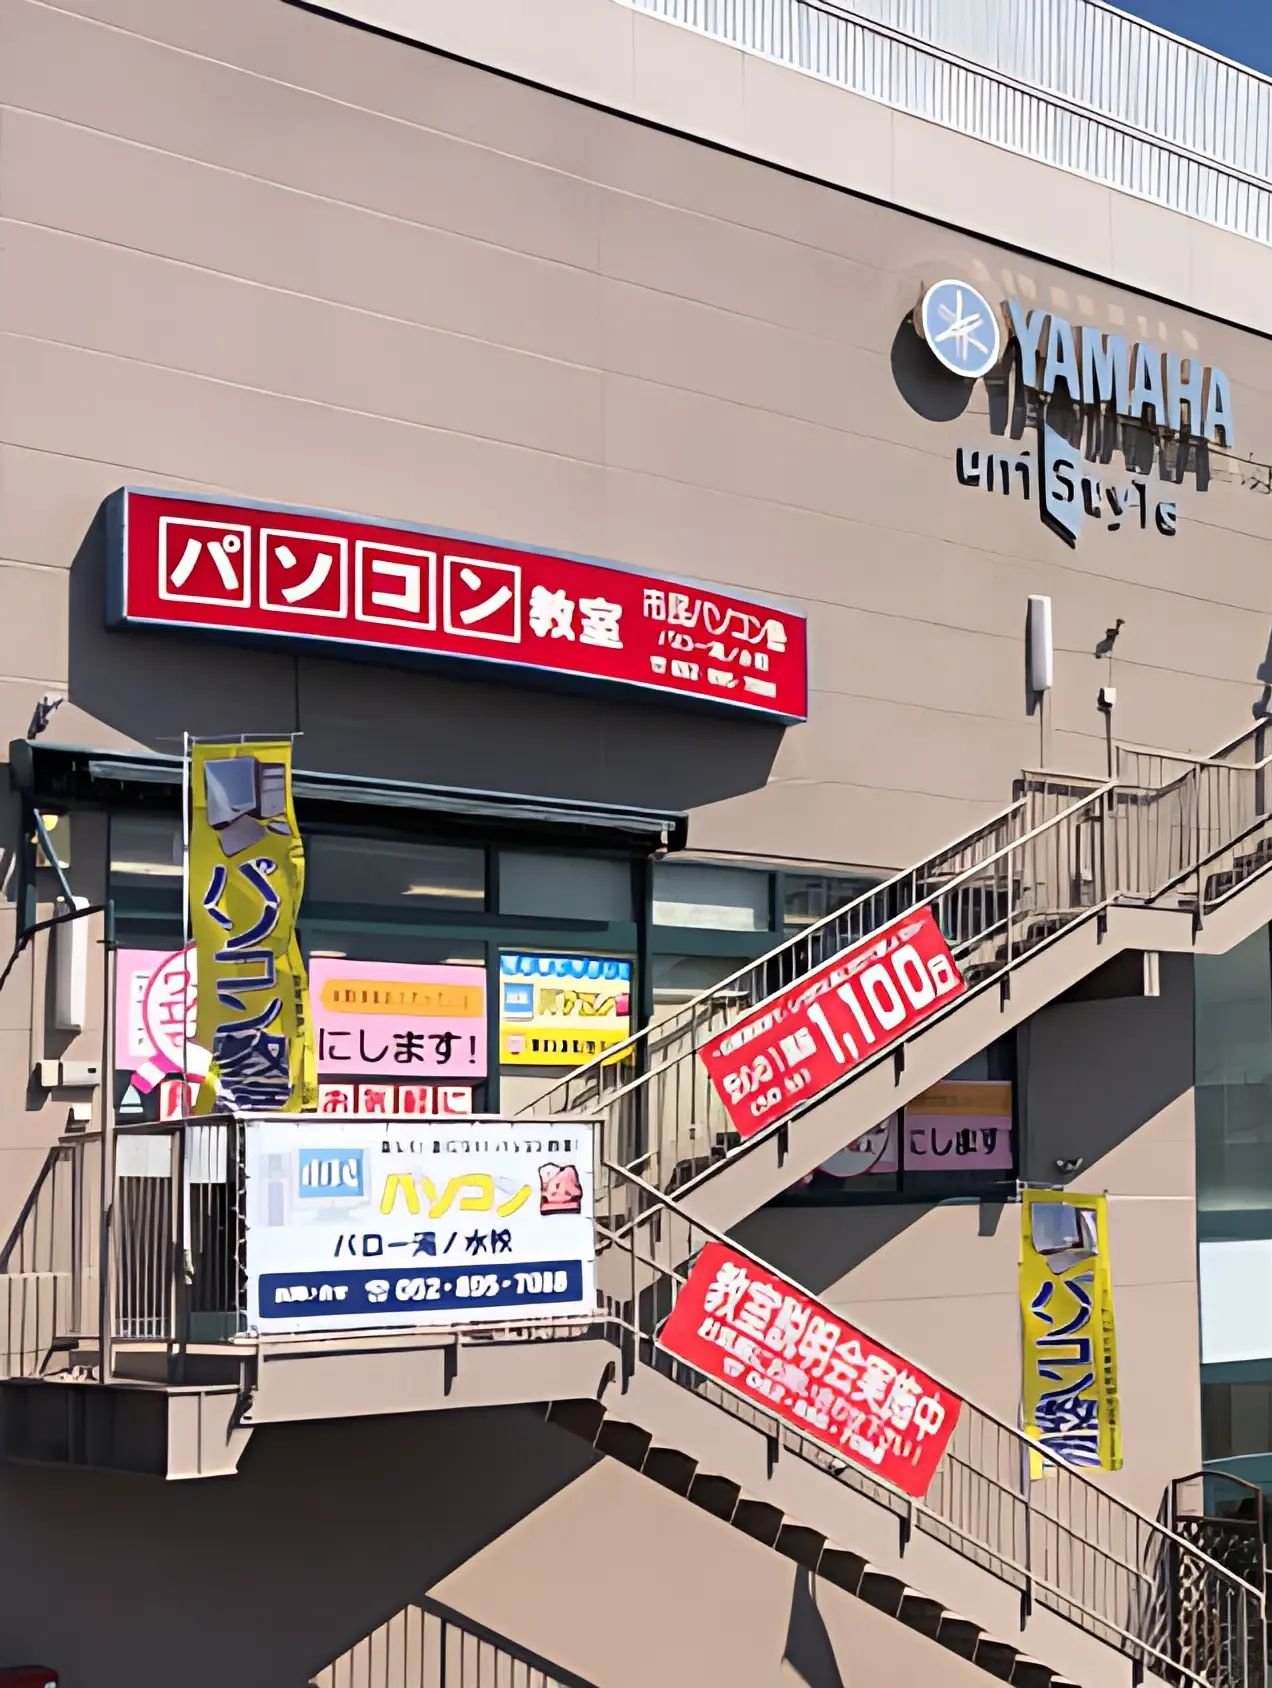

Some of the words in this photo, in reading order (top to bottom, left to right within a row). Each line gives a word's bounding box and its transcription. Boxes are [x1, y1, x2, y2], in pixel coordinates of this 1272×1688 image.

[1002, 297, 1234, 447] YAMAHA
[158, 516, 624, 649] パソコン教室
[704, 1261, 946, 1441] 教室説明会実施中
